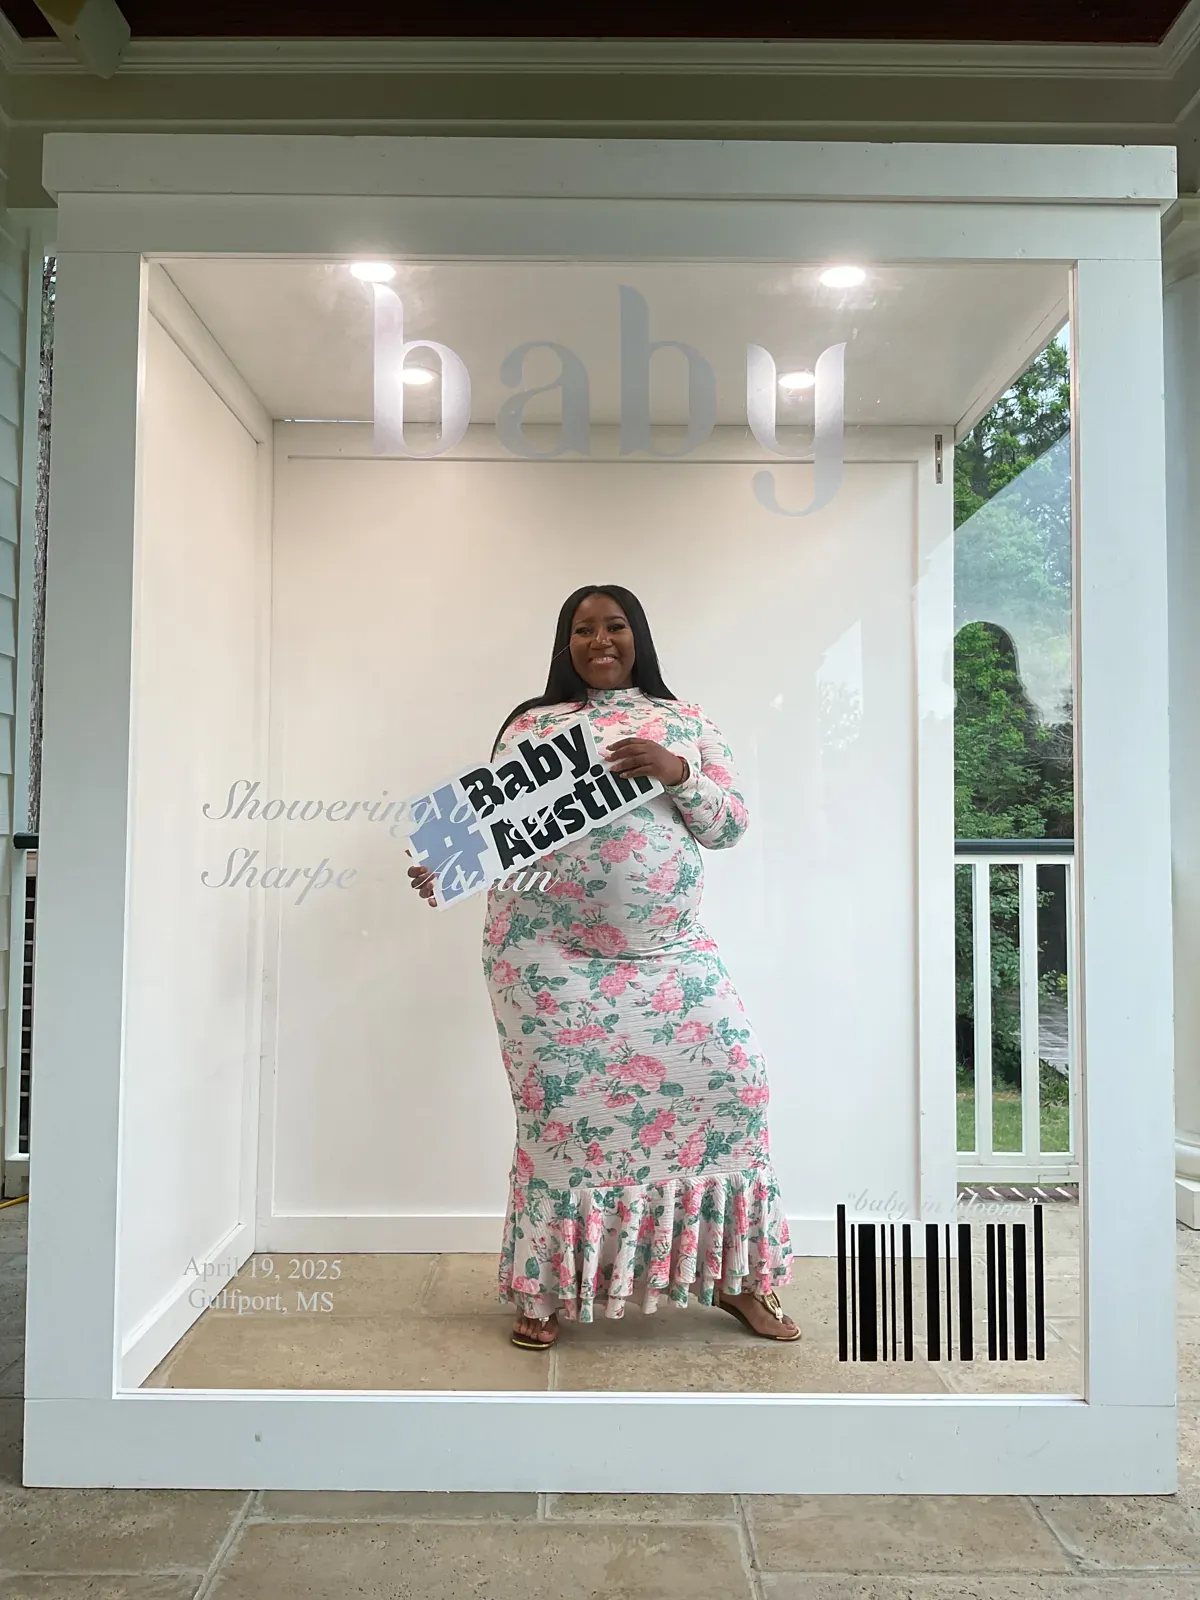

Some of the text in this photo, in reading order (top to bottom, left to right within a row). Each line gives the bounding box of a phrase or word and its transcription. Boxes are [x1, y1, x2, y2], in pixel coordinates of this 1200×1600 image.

[372, 281, 847, 518] baby
[458, 723, 591, 820] Baby
[202, 779, 441, 839] Showering
[489, 763, 655, 871] Austin
[200, 847, 358, 906] Sharpe
[412, 850, 561, 893] Auin
[182, 1255, 342, 1282] April 19, 2025
[188, 1288, 334, 1315] Gulfport, MS
